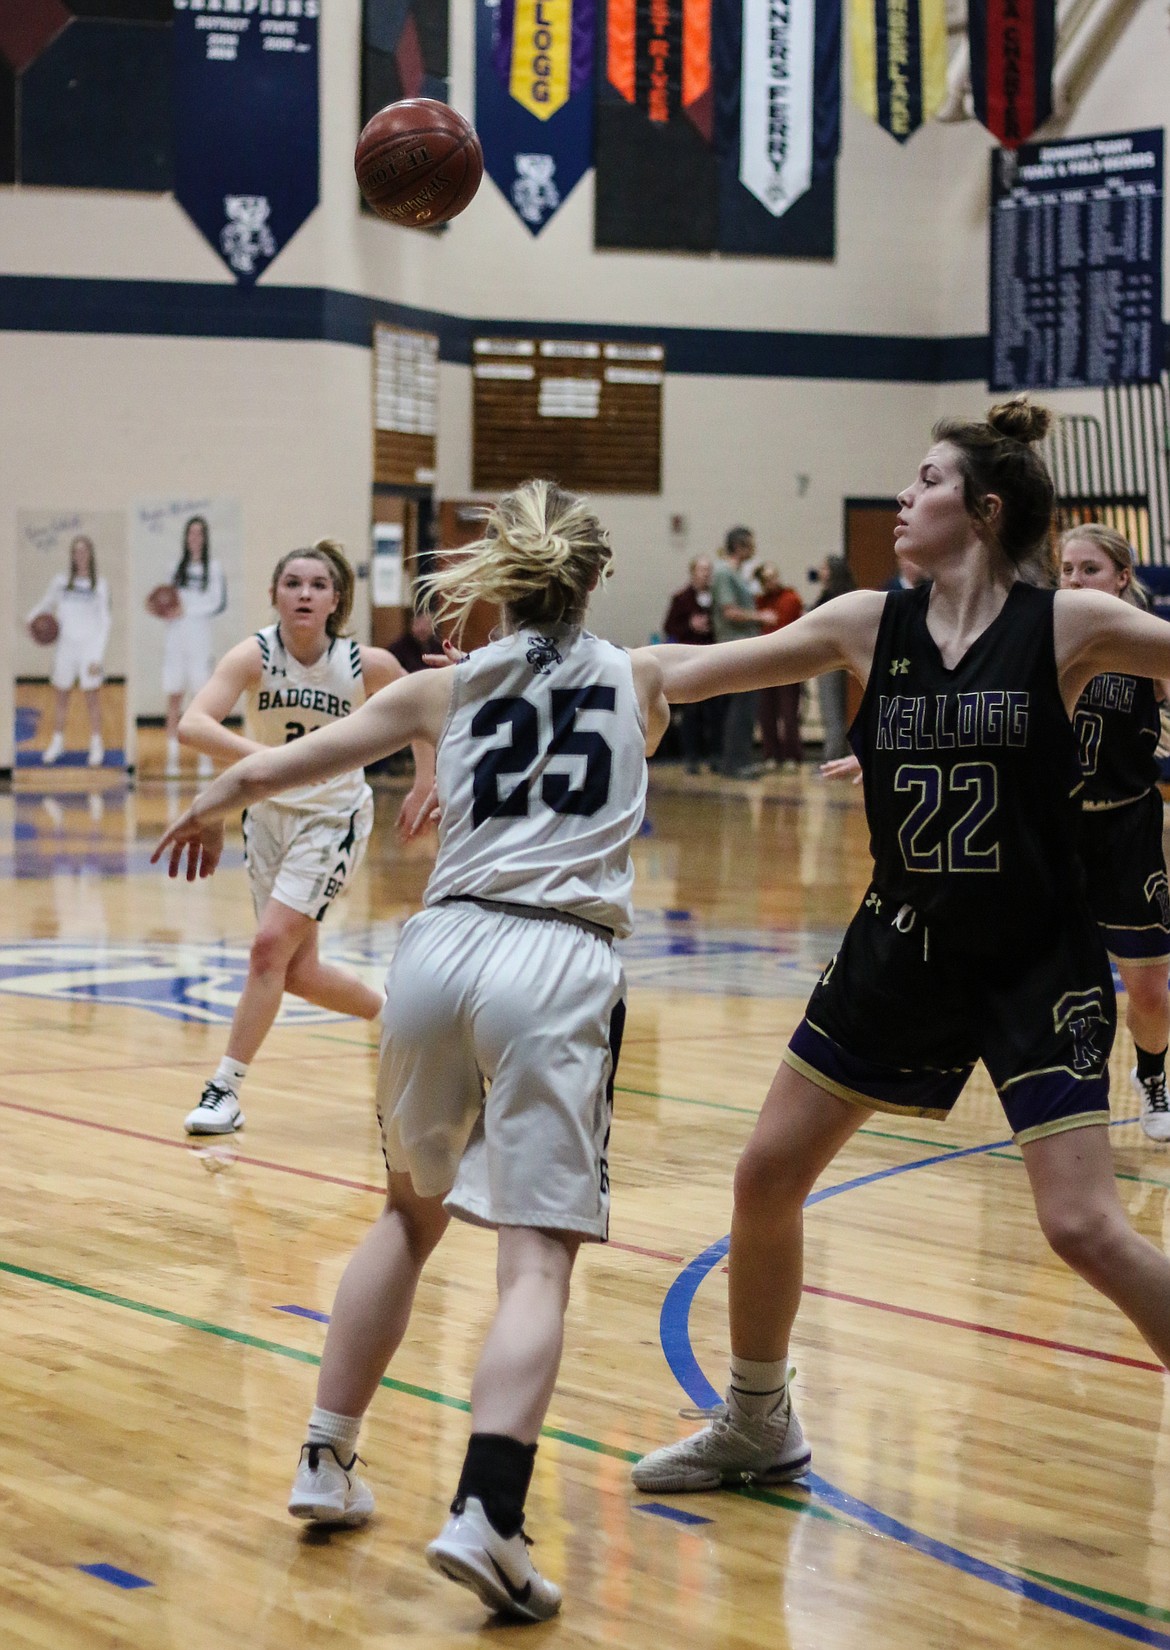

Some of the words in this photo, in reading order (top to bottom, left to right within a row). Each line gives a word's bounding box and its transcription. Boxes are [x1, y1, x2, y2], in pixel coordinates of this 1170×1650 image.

[258, 688, 352, 717] BADGERS
[285, 721, 320, 744] 2
[876, 691, 1030, 751] KELLOGG
[471, 685, 617, 830] 25
[894, 761, 1001, 873] 22
